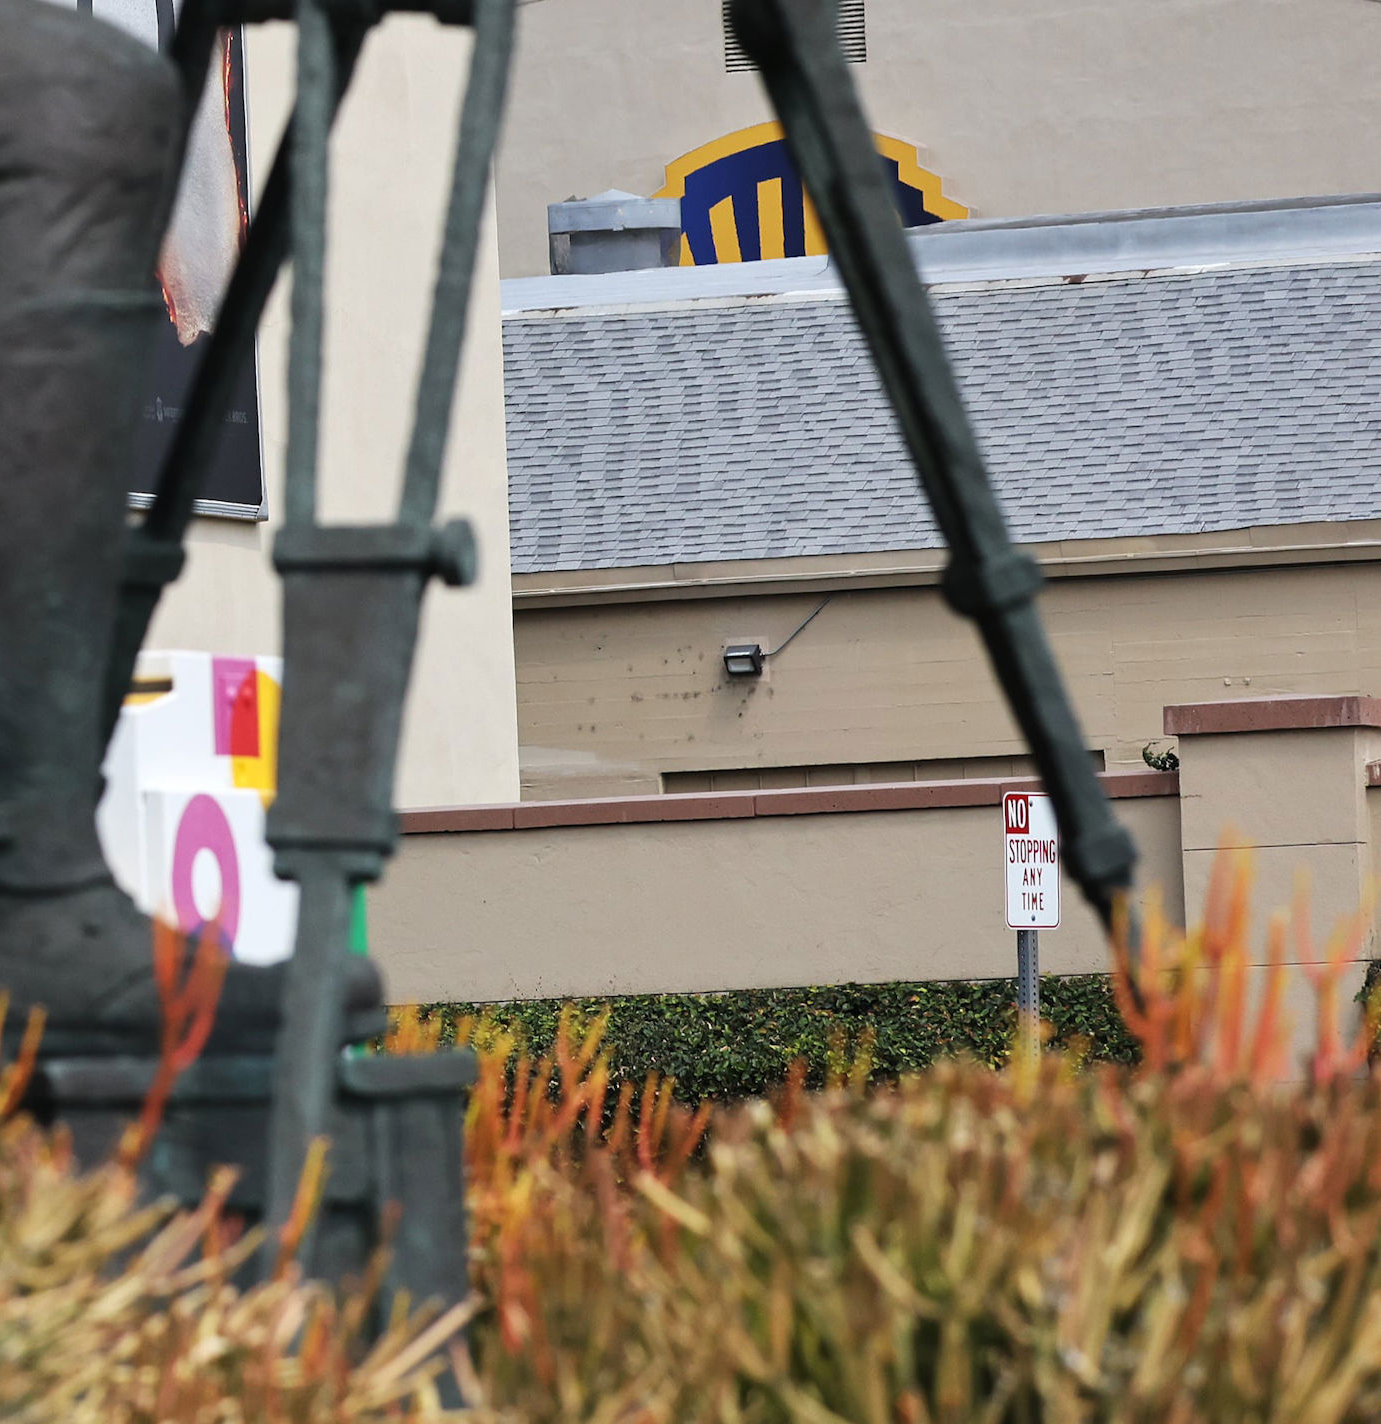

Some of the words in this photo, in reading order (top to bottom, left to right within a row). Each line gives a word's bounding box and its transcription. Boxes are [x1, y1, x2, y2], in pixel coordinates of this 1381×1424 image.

[1007, 798, 1027, 829] NO
[1009, 839, 1056, 864] STOPPING
[1022, 868, 1043, 886] ANY
[1022, 892, 1044, 911] TIME
